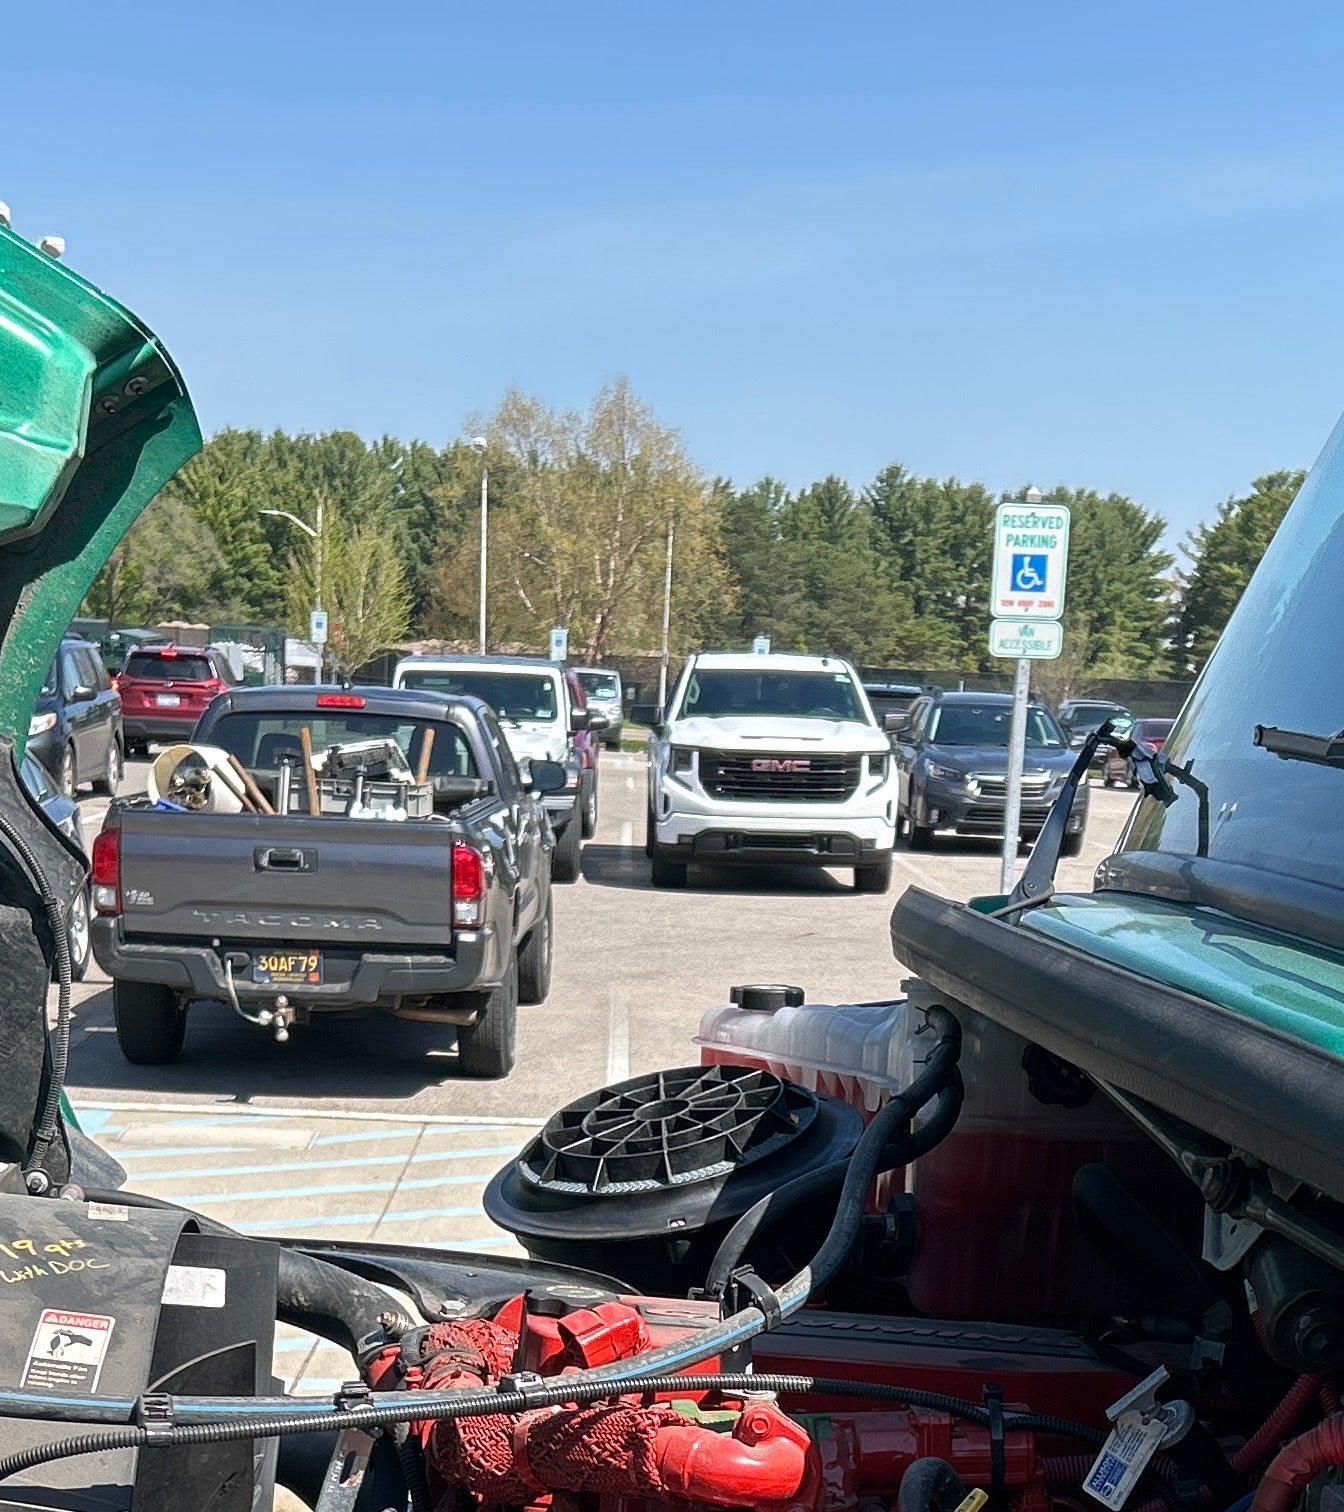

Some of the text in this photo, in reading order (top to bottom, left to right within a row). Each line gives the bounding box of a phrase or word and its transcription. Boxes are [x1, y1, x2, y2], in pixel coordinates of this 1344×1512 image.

[1002, 514, 1064, 529] RESERVED
[1006, 534, 1058, 548] PARKING
[999, 639, 1053, 650] ACCESSIBLE
[752, 759, 811, 772] GMC
[192, 910, 383, 930] TACOMA
[48, 1258, 110, 1275] DOC
[59, 1314, 109, 1329] DANGER
